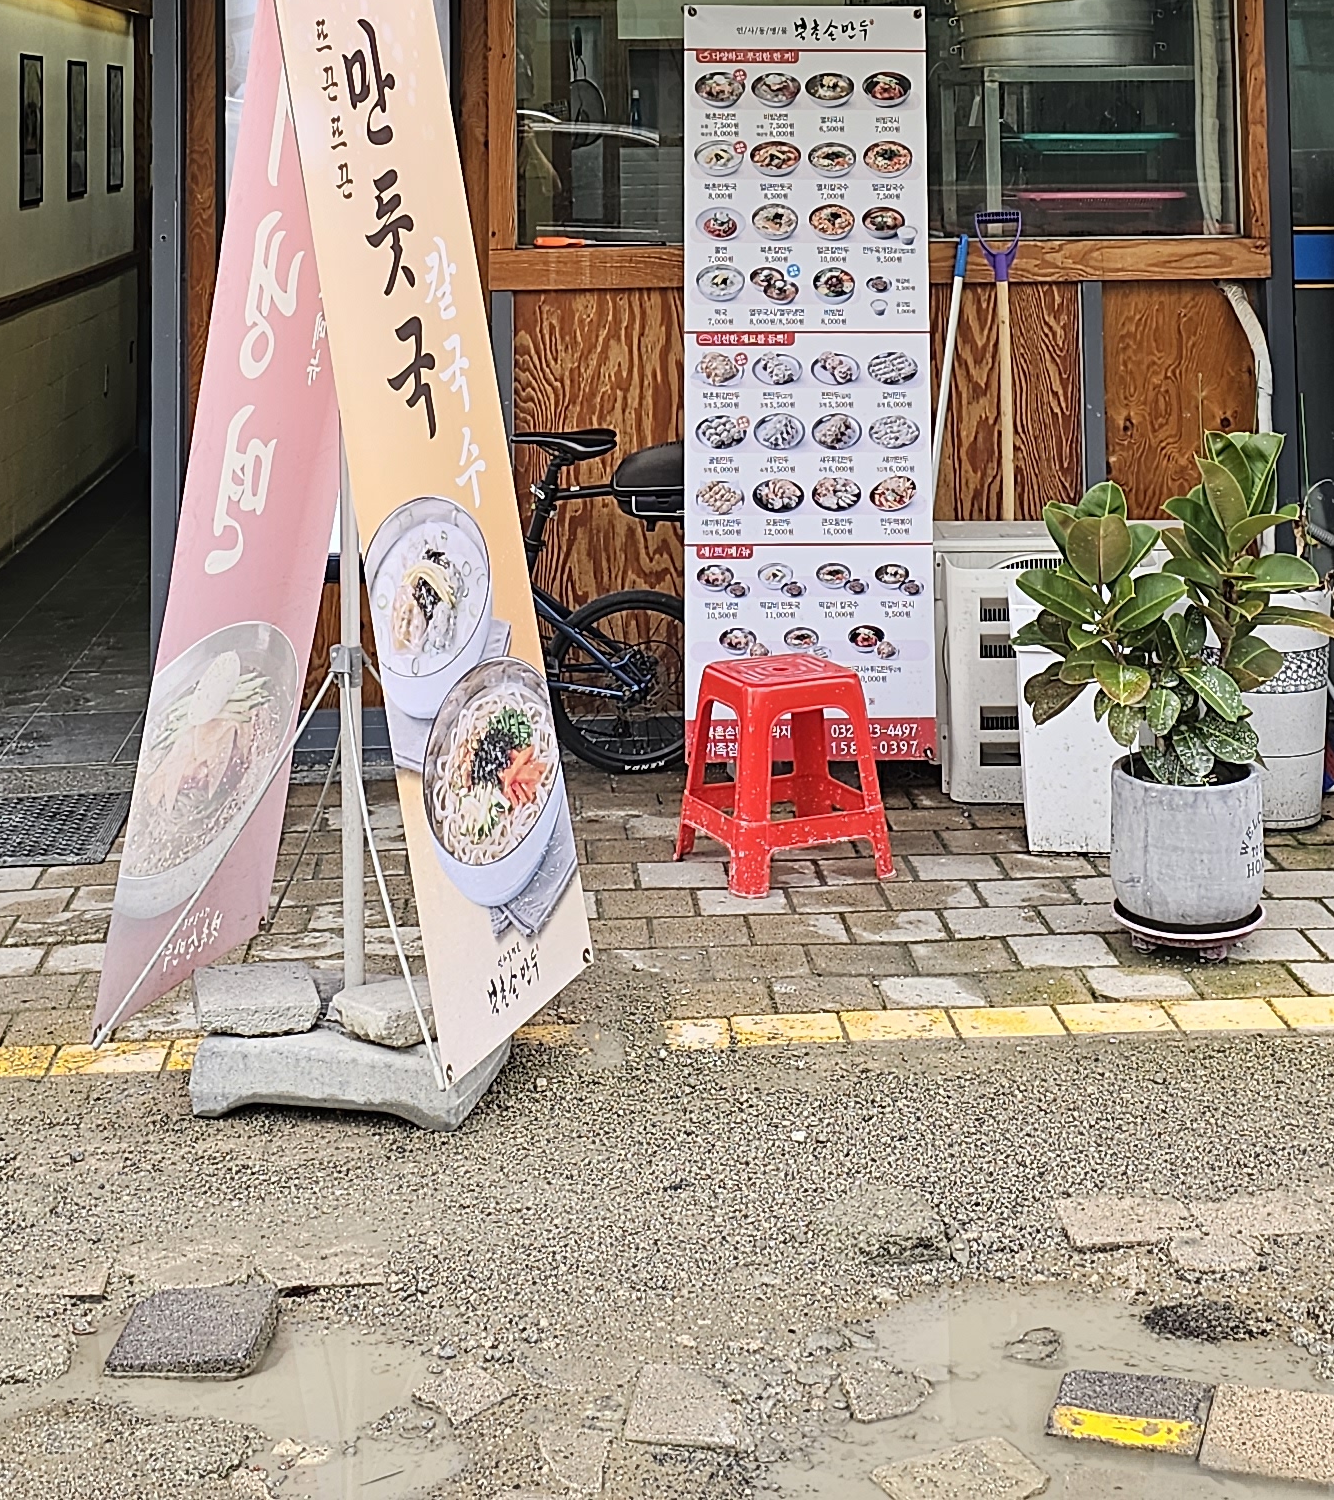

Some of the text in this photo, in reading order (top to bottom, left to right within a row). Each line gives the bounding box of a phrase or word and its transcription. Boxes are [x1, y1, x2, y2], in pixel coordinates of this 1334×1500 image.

[793, 17, 869, 42] 북촌손만두
[341, 18, 439, 441] 만둣국
[707, 317, 734, 325] 7,000원
[713, 334, 738, 344] 신선한
[423, 236, 487, 509] 칼국수
[624, 760, 665, 771] KENDA
